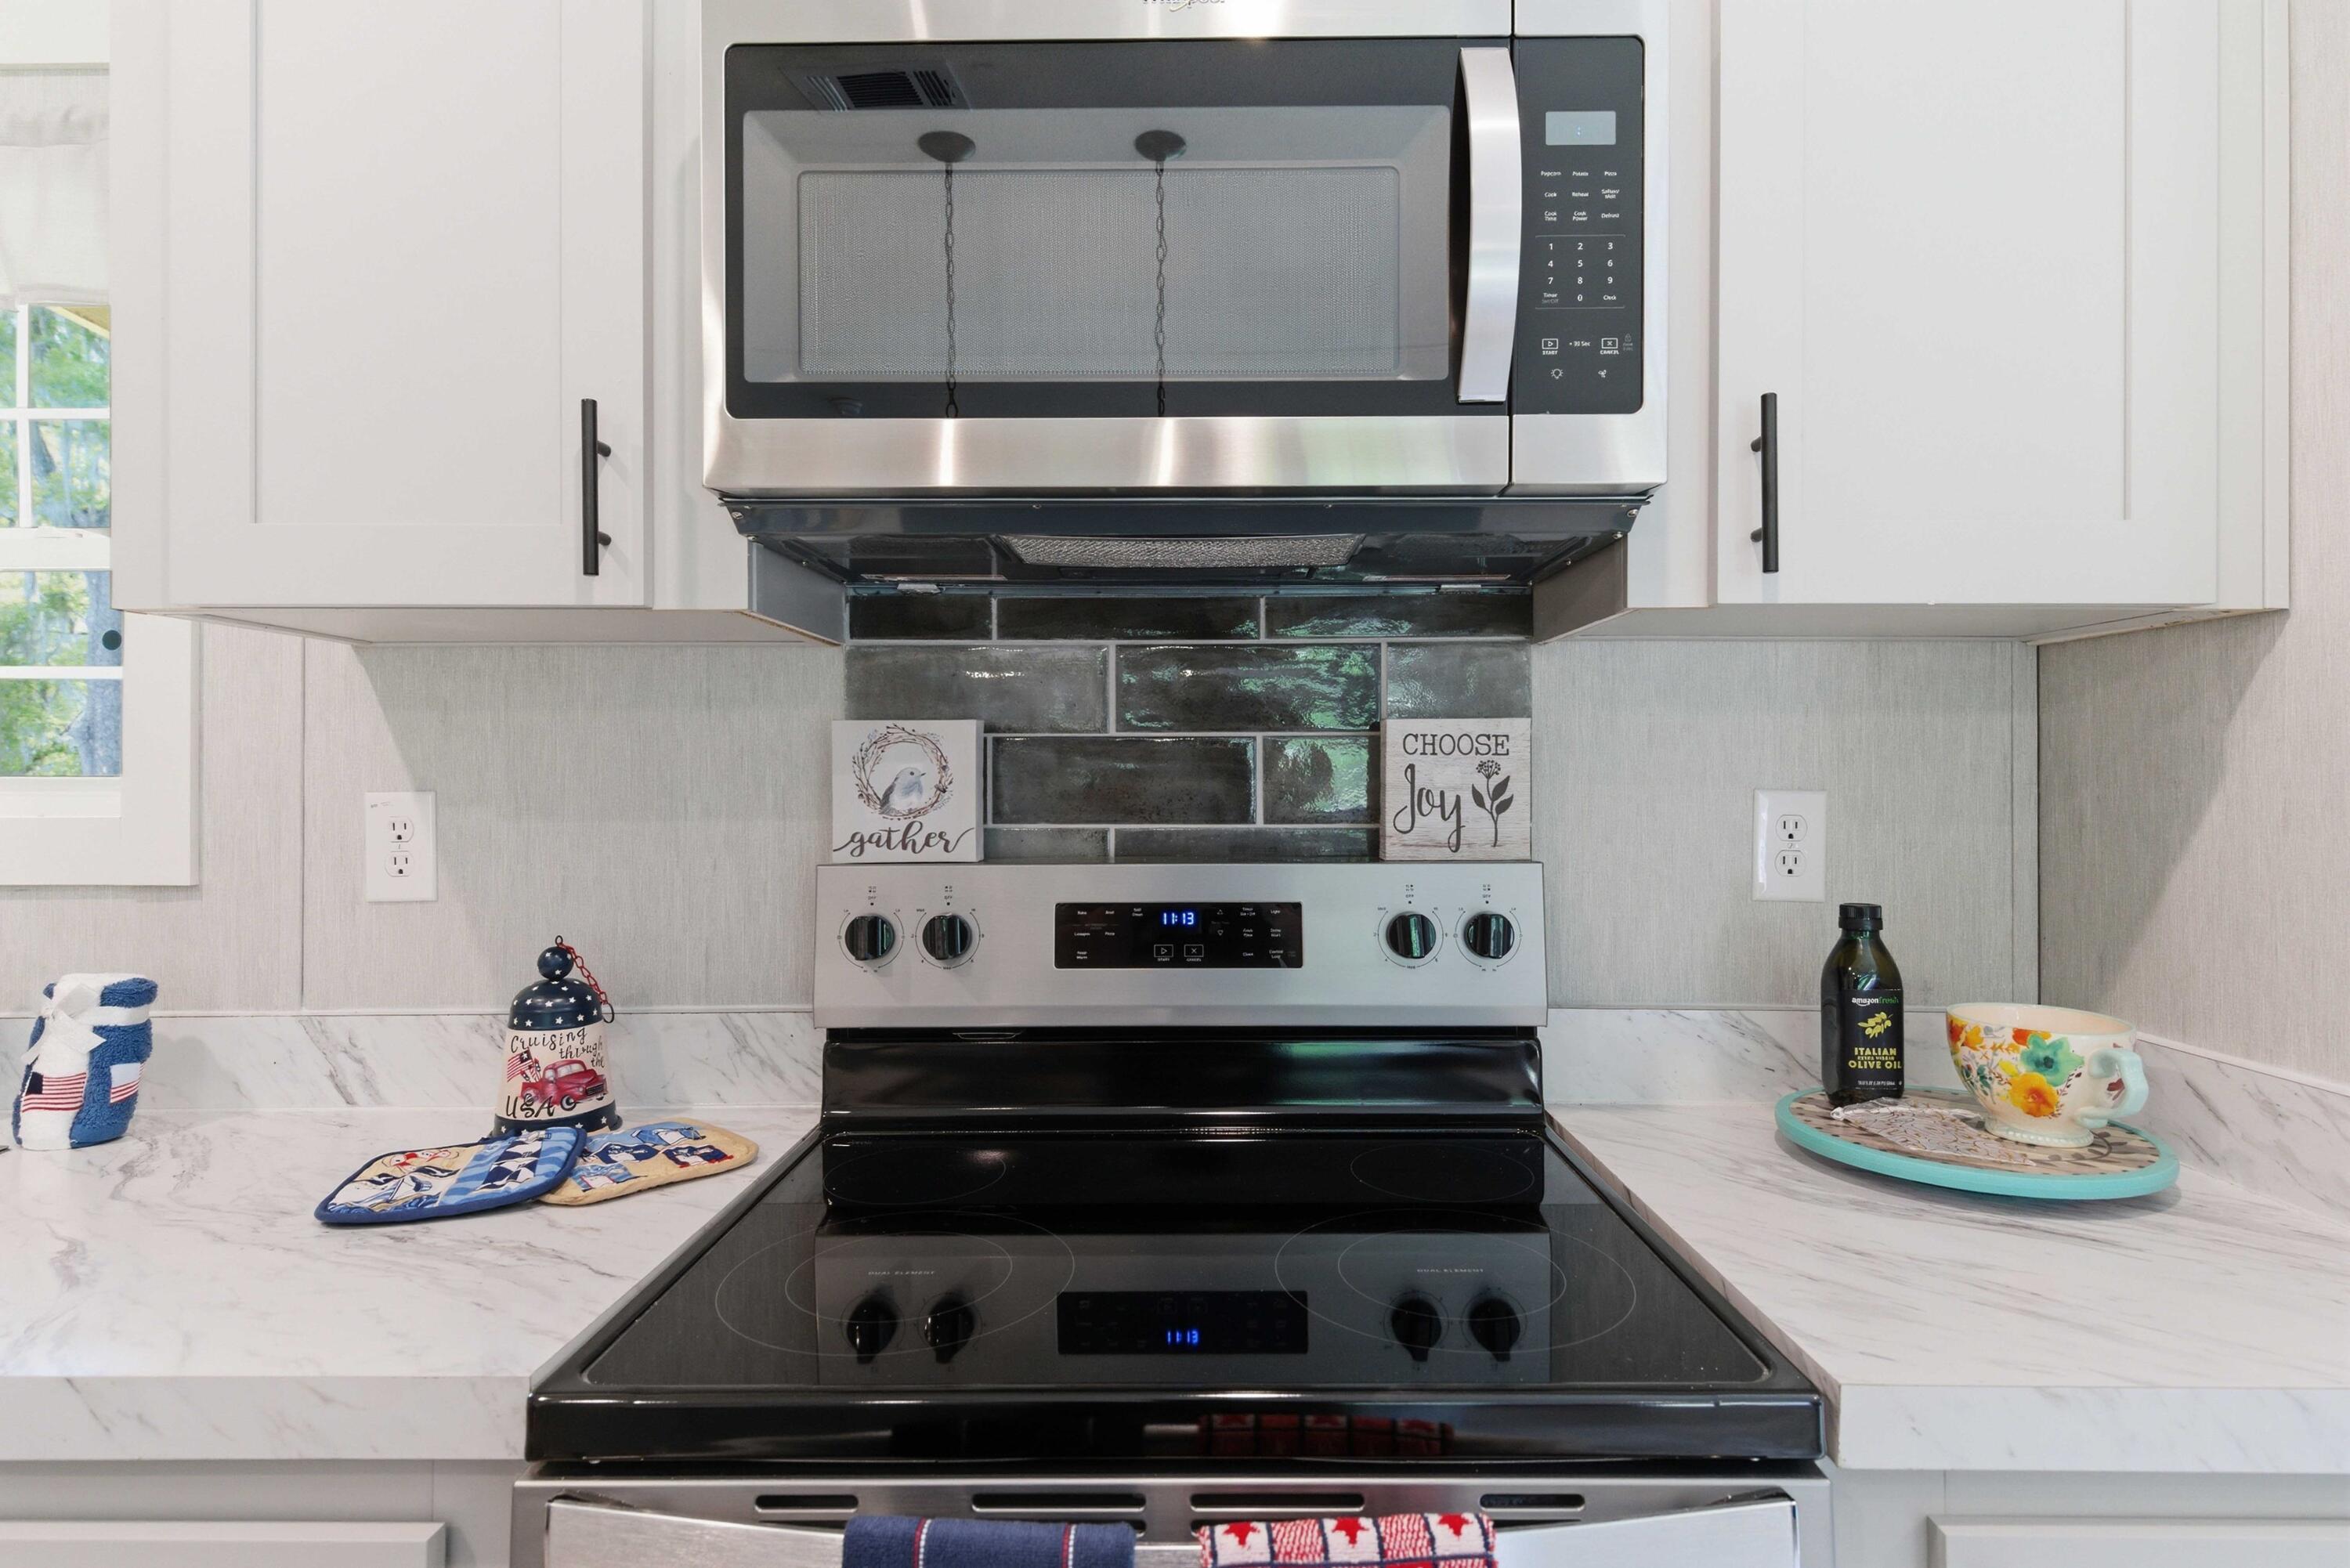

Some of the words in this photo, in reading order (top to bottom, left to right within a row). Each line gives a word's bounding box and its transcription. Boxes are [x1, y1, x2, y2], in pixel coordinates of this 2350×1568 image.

[1403, 733, 1509, 756] CHOOSE
[1394, 764, 1466, 853] Joy
[833, 821, 974, 857] gather
[1163, 912, 1195, 925] 11:13
[511, 1028, 587, 1053] Cruising
[1854, 1047, 1896, 1056] ITALIAN
[591, 1053, 605, 1068] the
[1849, 1060, 1882, 1069] OLIVE
[1885, 1060, 1902, 1069] OIL
[506, 1095, 555, 1118] USA
